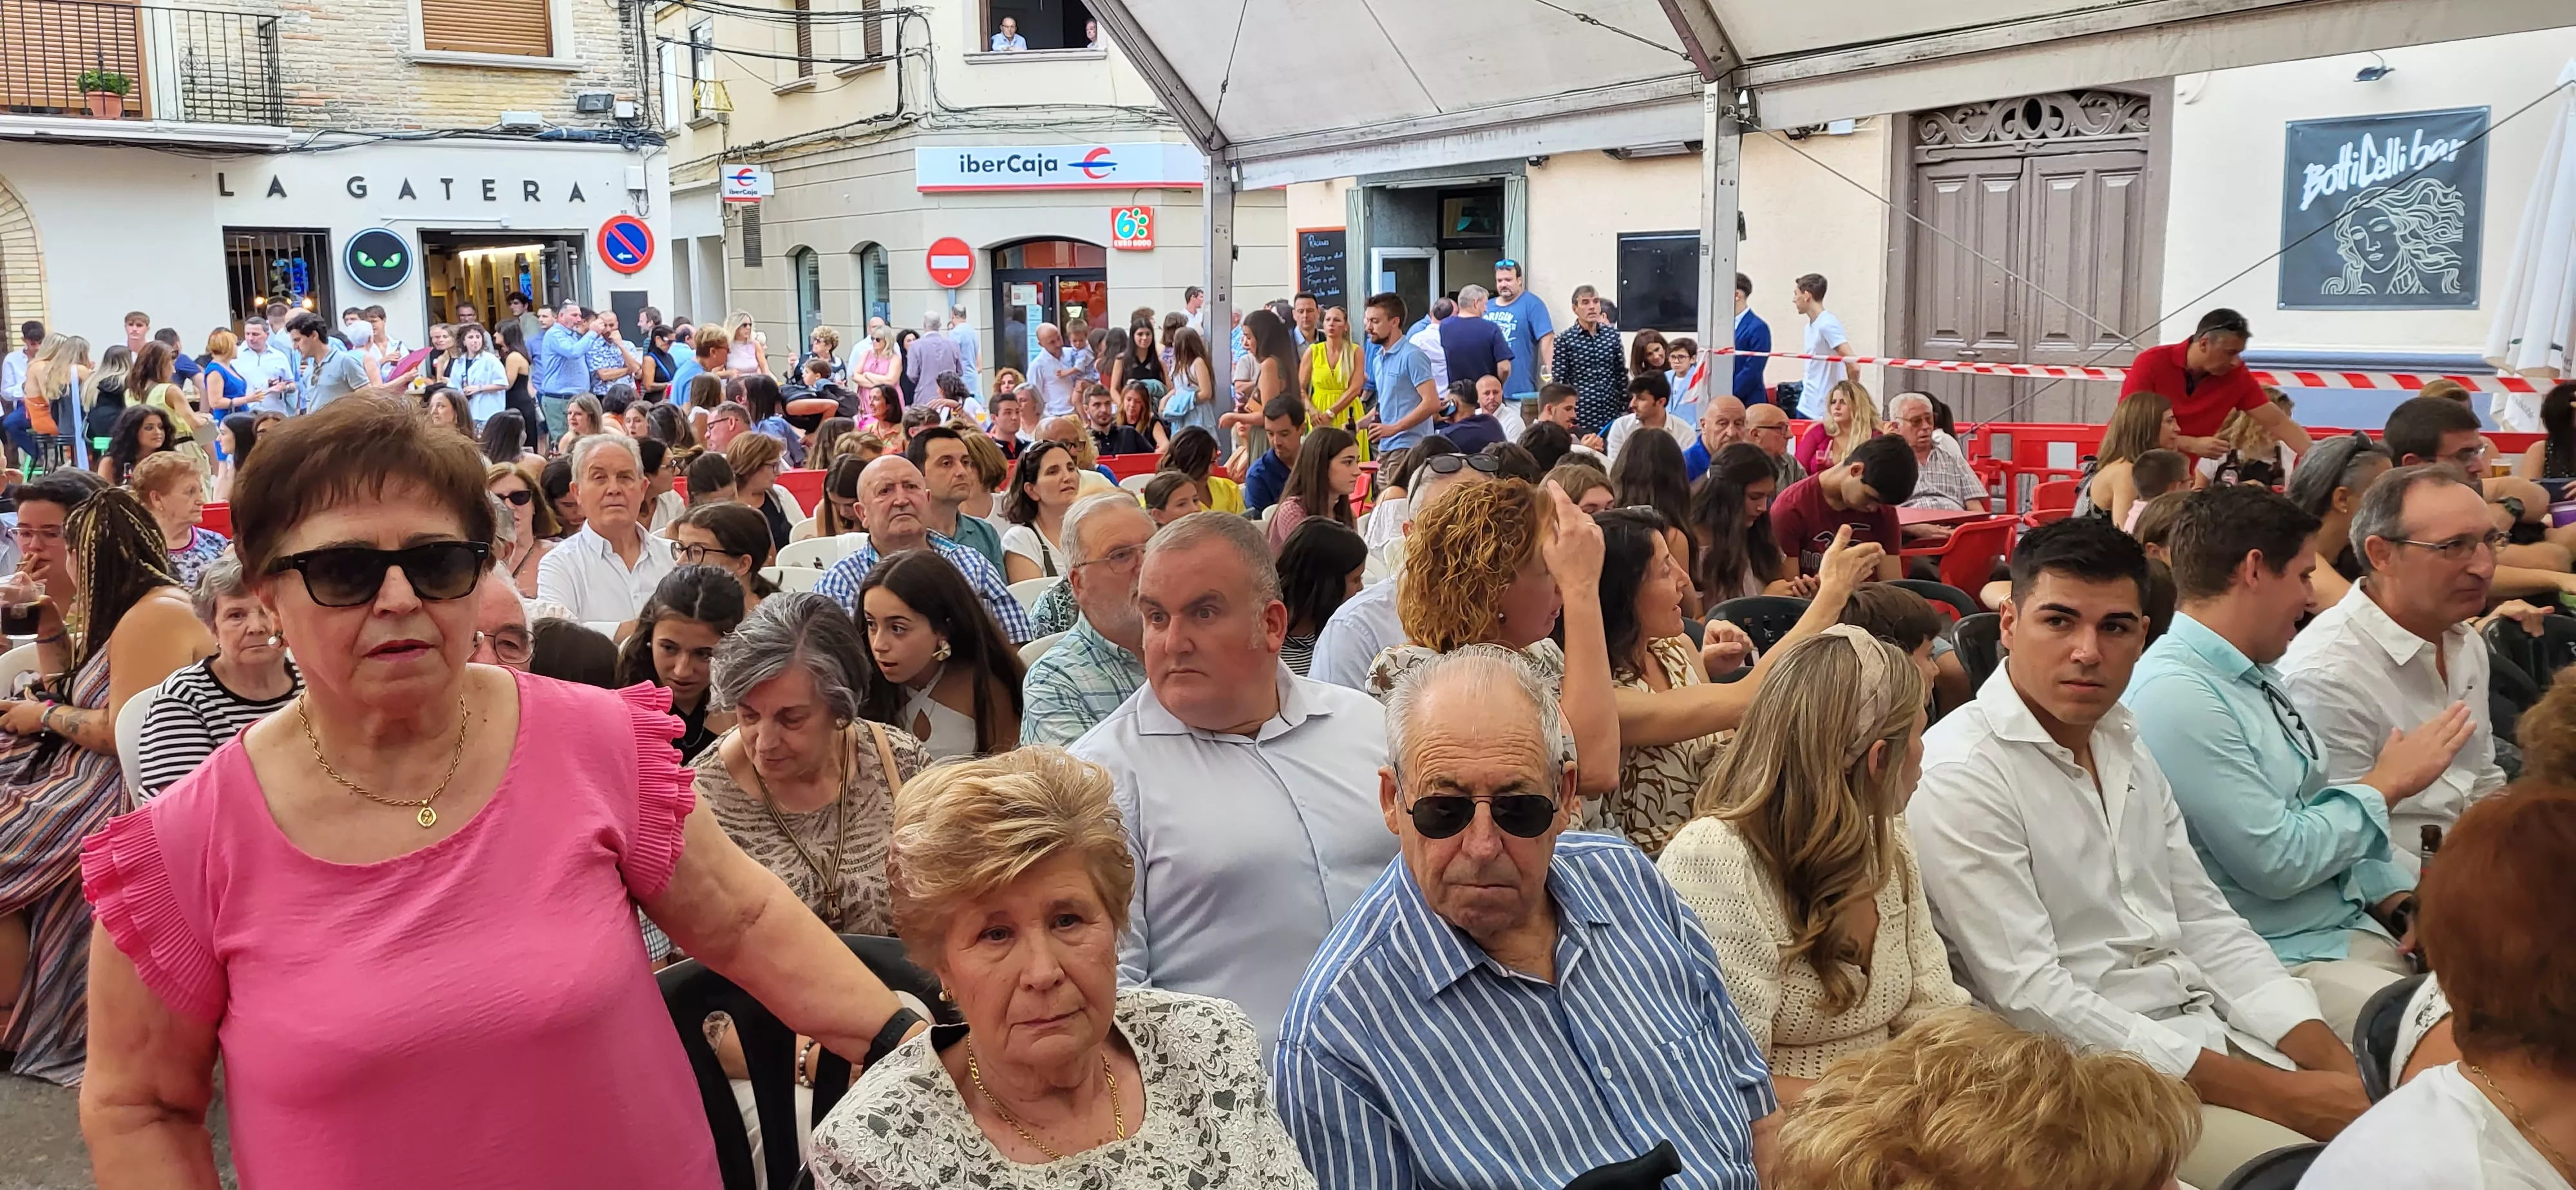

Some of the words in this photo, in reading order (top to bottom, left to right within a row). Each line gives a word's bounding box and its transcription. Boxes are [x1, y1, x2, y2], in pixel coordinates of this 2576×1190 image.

[960, 153, 1058, 177] iberCaja
[2409, 129, 2467, 171] bar
[218, 172, 287, 198] LA
[346, 176, 586, 202] GATERA
